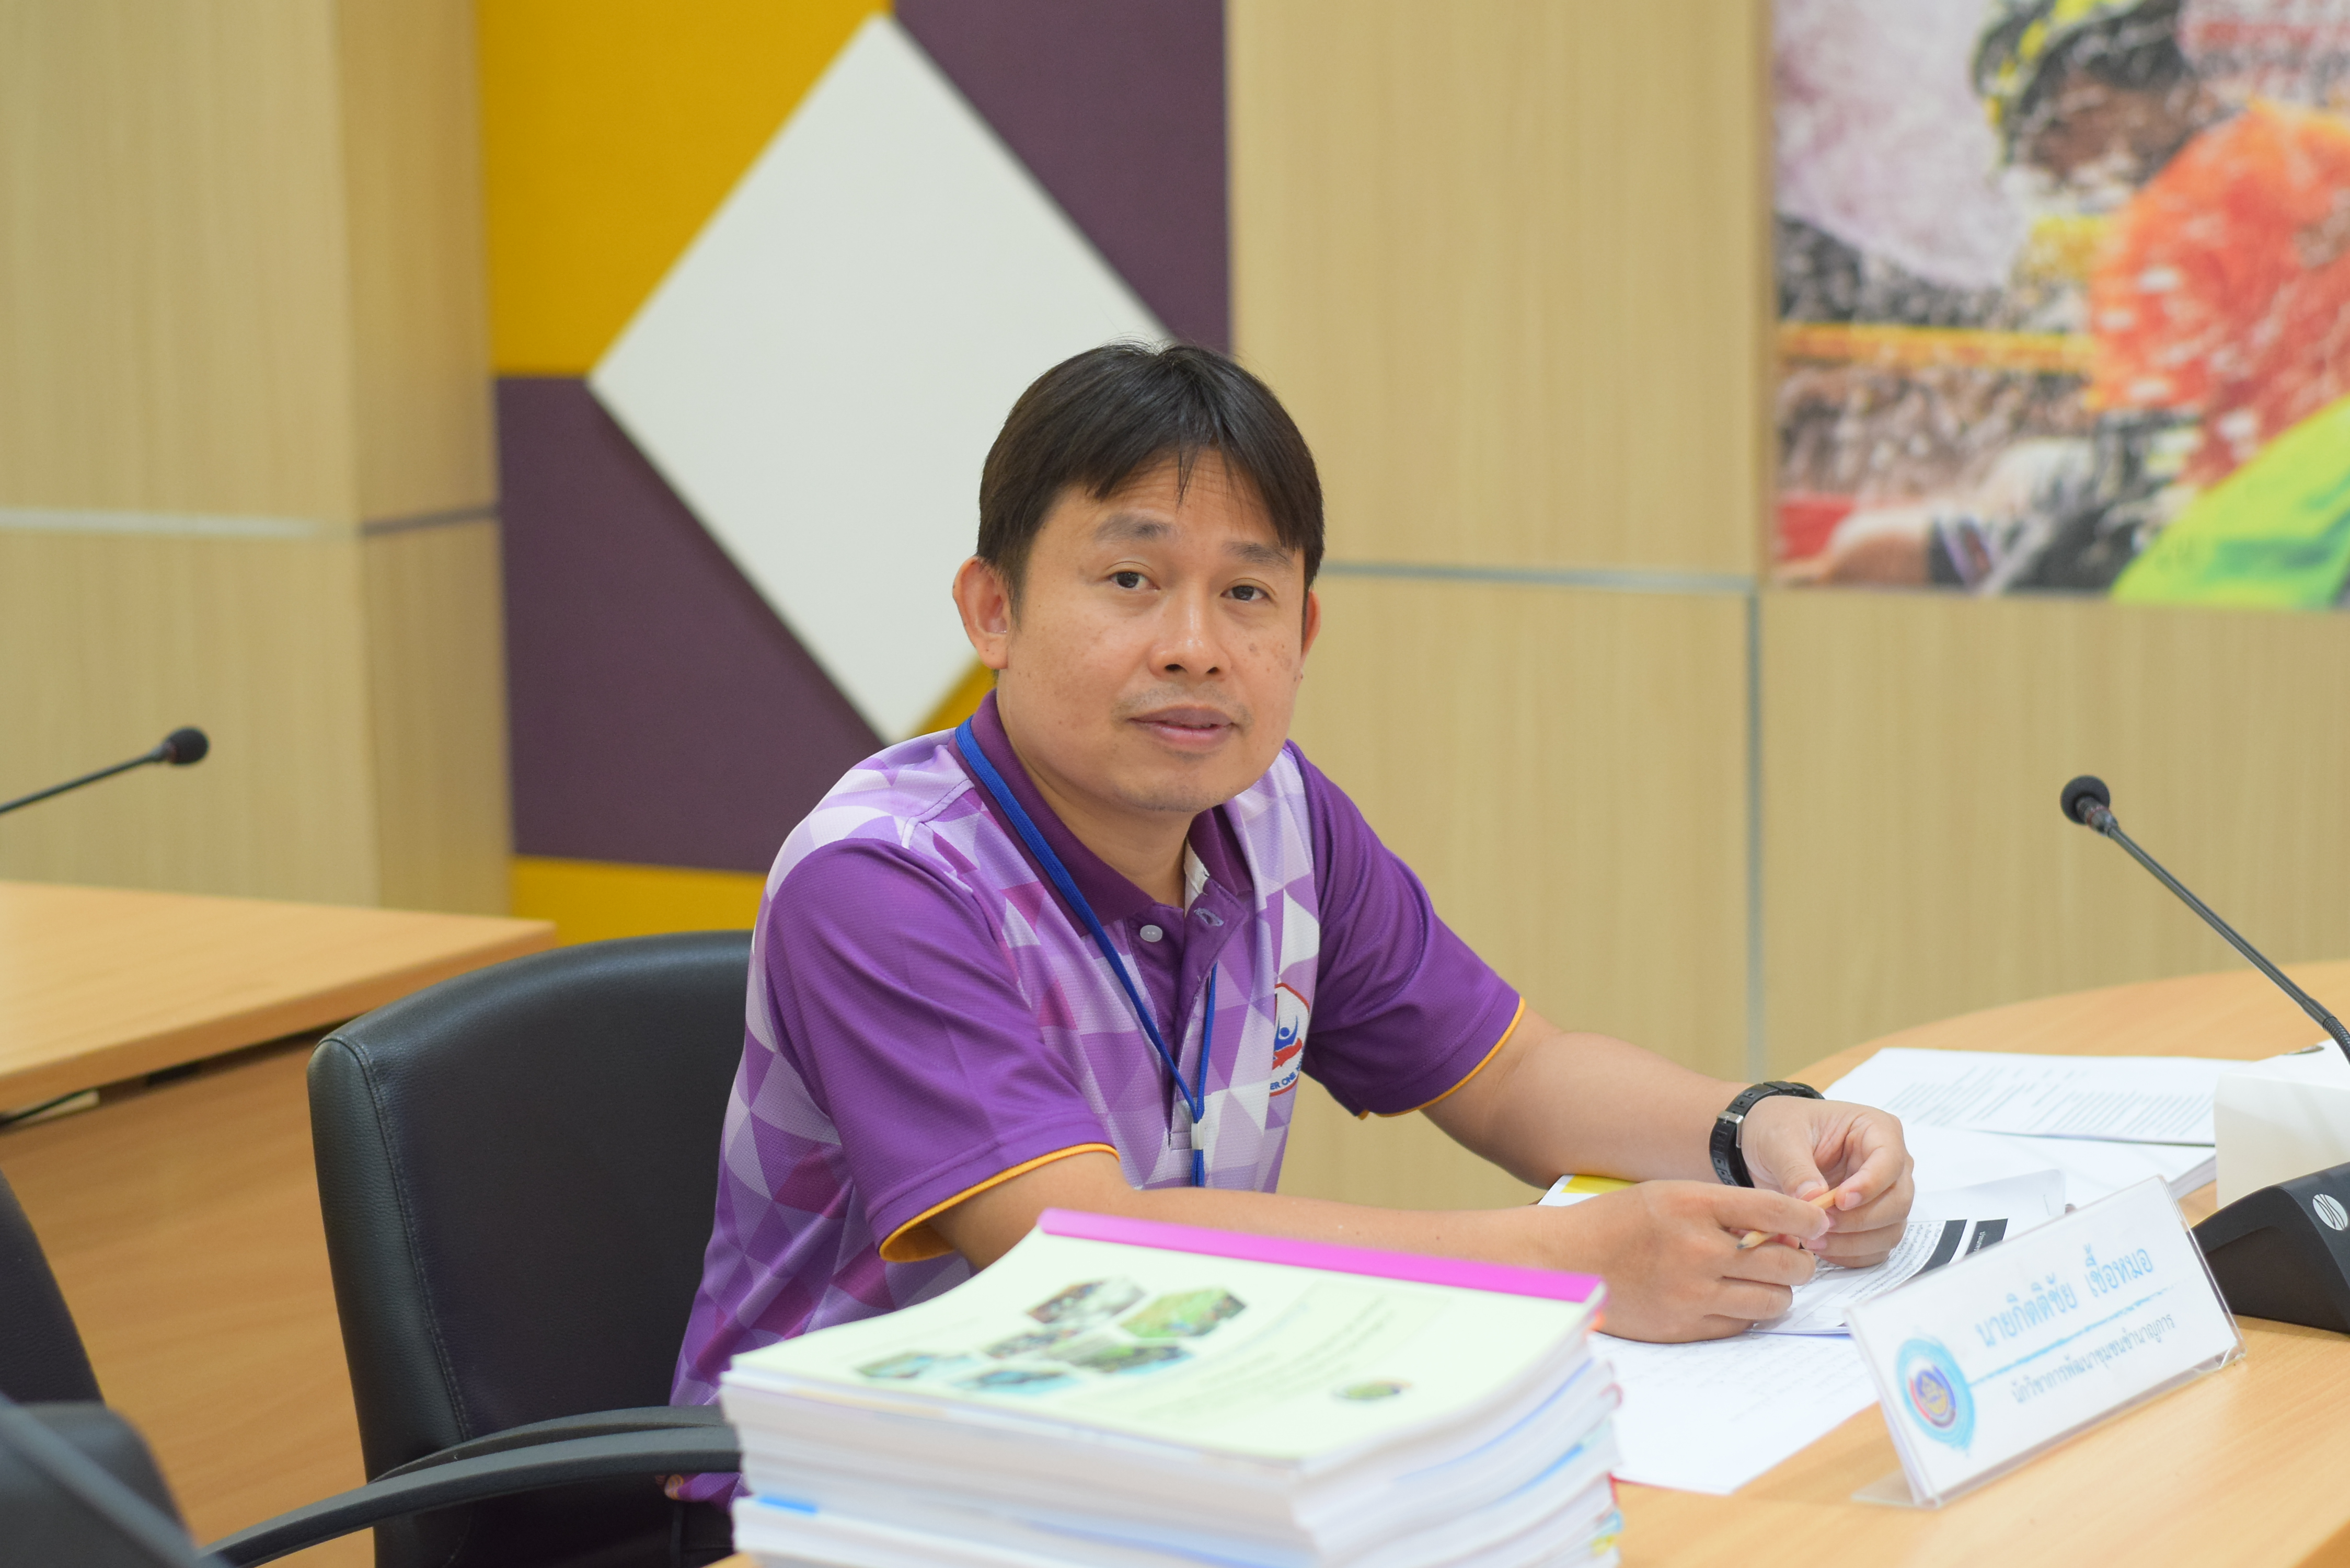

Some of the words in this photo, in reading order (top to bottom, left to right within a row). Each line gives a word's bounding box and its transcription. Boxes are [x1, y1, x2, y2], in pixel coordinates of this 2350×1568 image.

[1282, 1071, 1296, 1086] ONE
[1974, 1271, 2078, 1347] นายกิตติชัย
[2083, 1242, 2153, 1298] เชื้อหมอ
